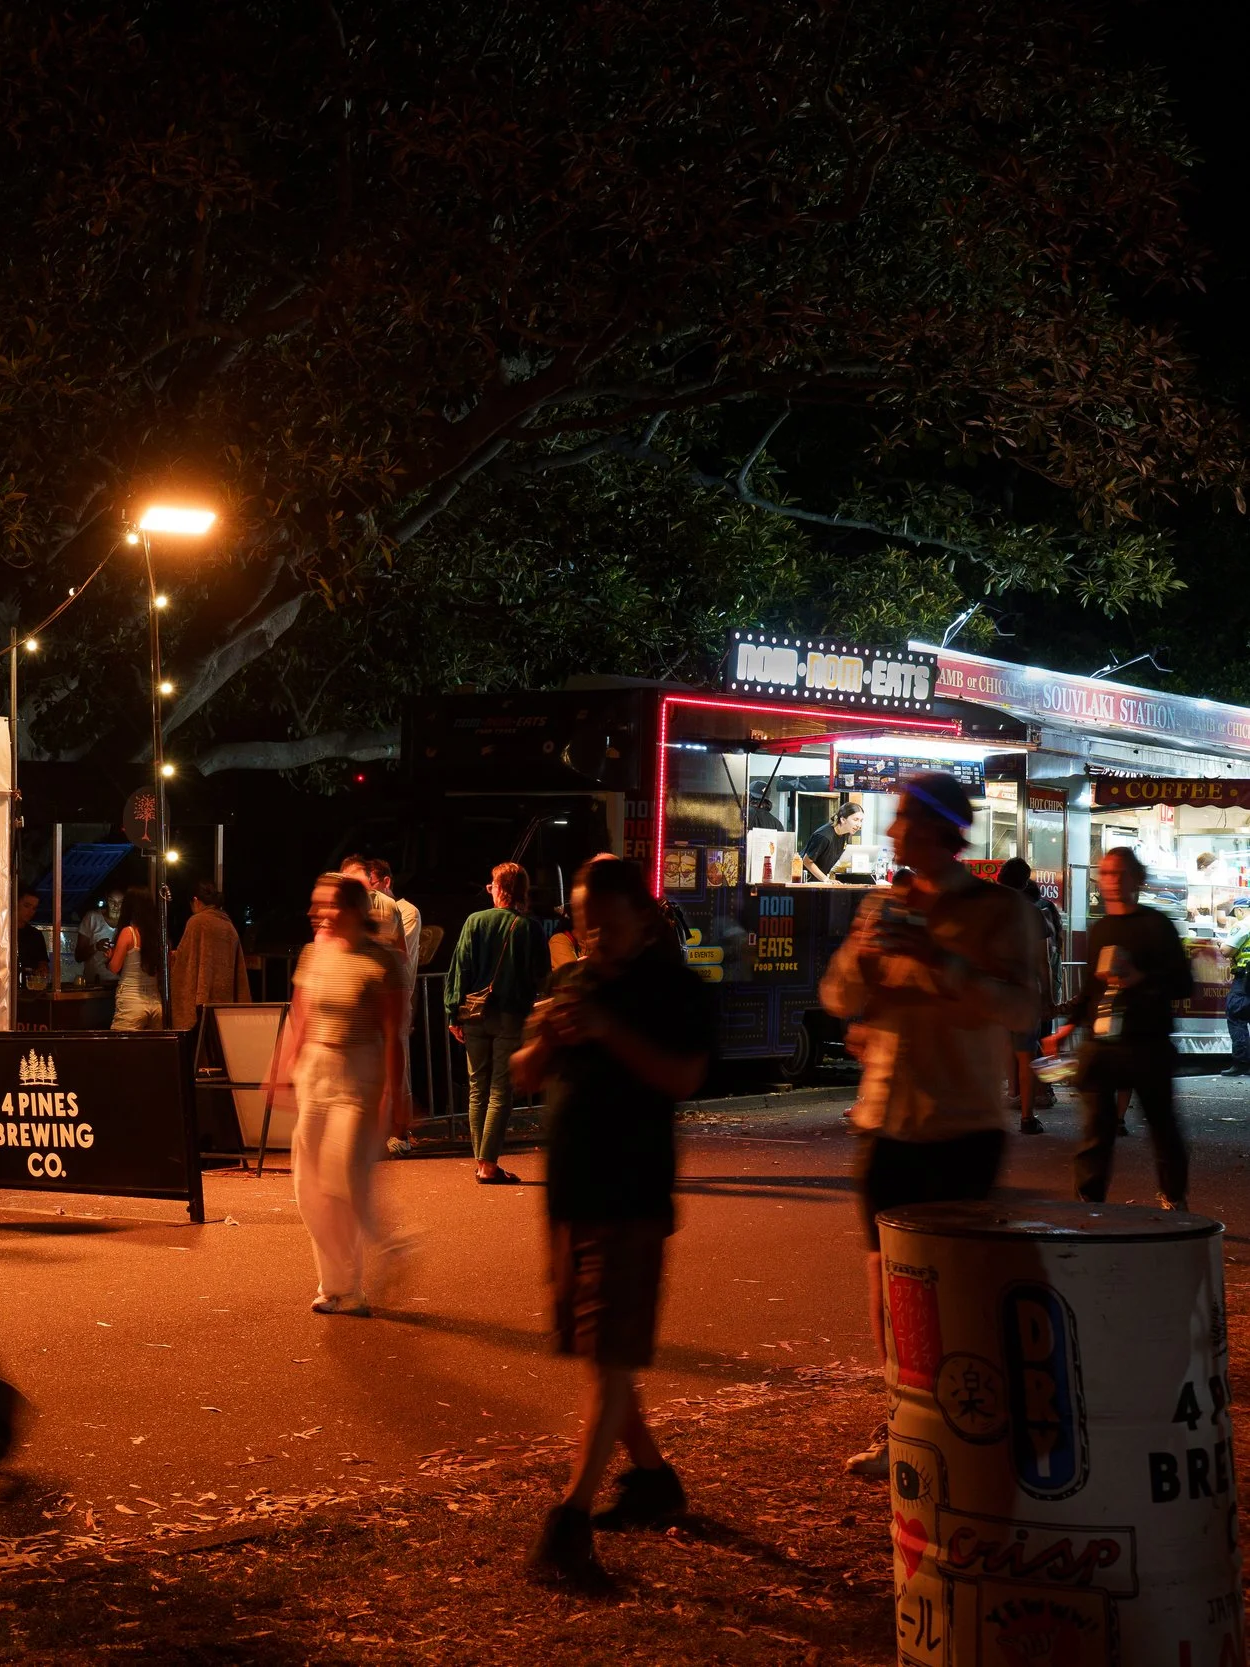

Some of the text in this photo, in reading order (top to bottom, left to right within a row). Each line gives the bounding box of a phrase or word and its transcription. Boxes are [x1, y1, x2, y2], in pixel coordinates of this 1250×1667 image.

[870, 659, 930, 700] EATS
[936, 667, 1026, 699] AMB or CHICKEN
[1043, 683, 1176, 730] SOUVLAKI STATION
[1125, 781, 1223, 800] COFFEE
[1029, 797, 1064, 811] HOT CHIPS
[1035, 870, 1057, 885] HOT
[1039, 885, 1059, 899] OGS
[694, 951, 715, 959] EVENTS
[758, 937, 793, 958] EATS
[753, 962, 799, 972] FOOD TRUCK
[1, 1091, 79, 1117] 4 PINES
[27, 1152, 67, 1178] CO.
[1015, 1299, 1061, 1478] DRY
[1172, 1381, 1202, 1430] 4
